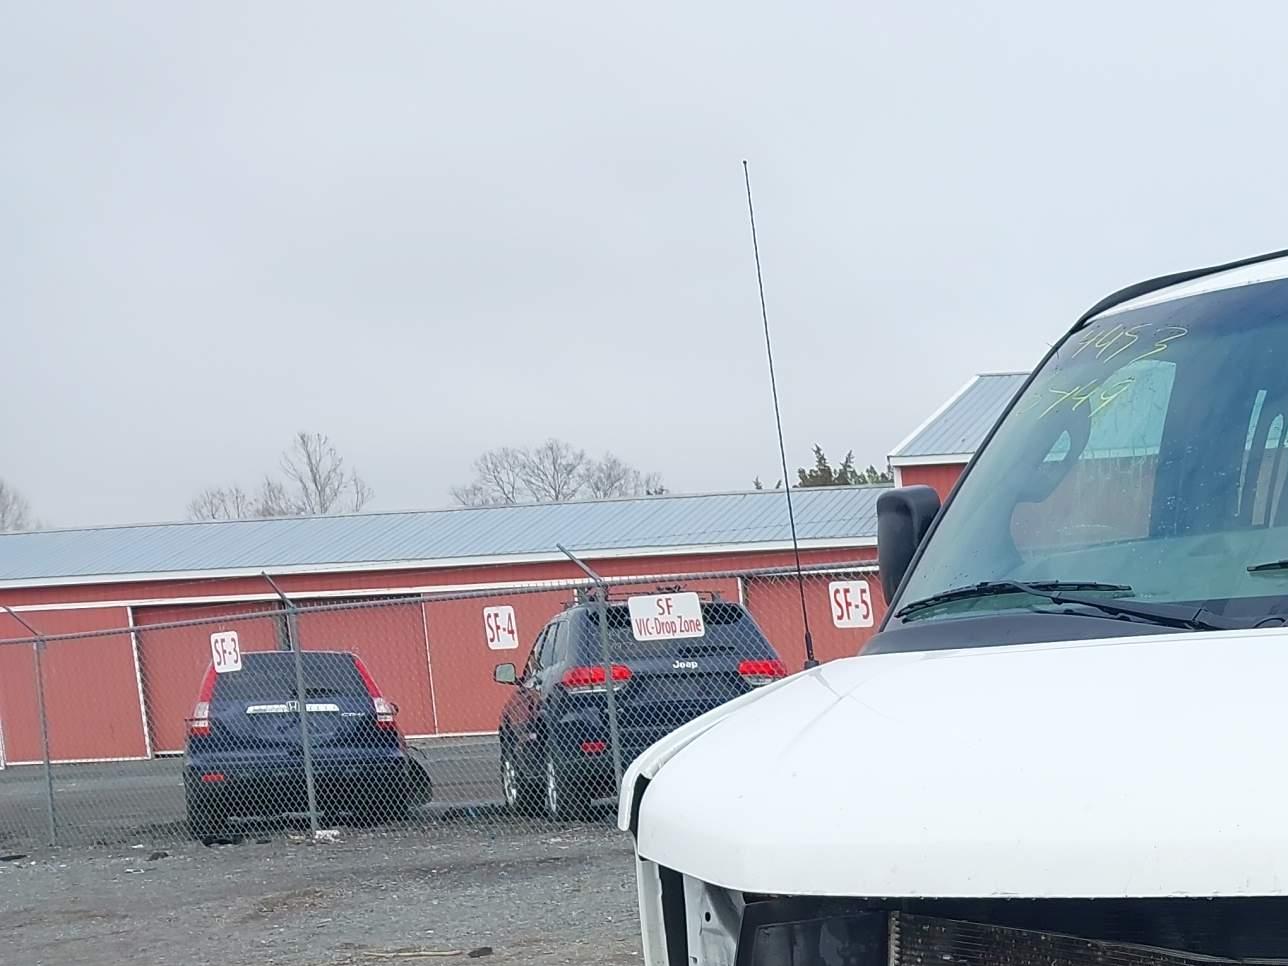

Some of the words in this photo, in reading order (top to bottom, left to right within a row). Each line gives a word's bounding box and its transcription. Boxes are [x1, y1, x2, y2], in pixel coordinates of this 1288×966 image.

[655, 597, 673, 616] SF
[833, 587, 871, 621] SF-5
[486, 612, 516, 643] SF-4
[635, 616, 677, 637] VIC-Drop
[677, 615, 702, 633] Zone
[213, 636, 239, 667] SF-3
[672, 660, 698, 670] Jeep
